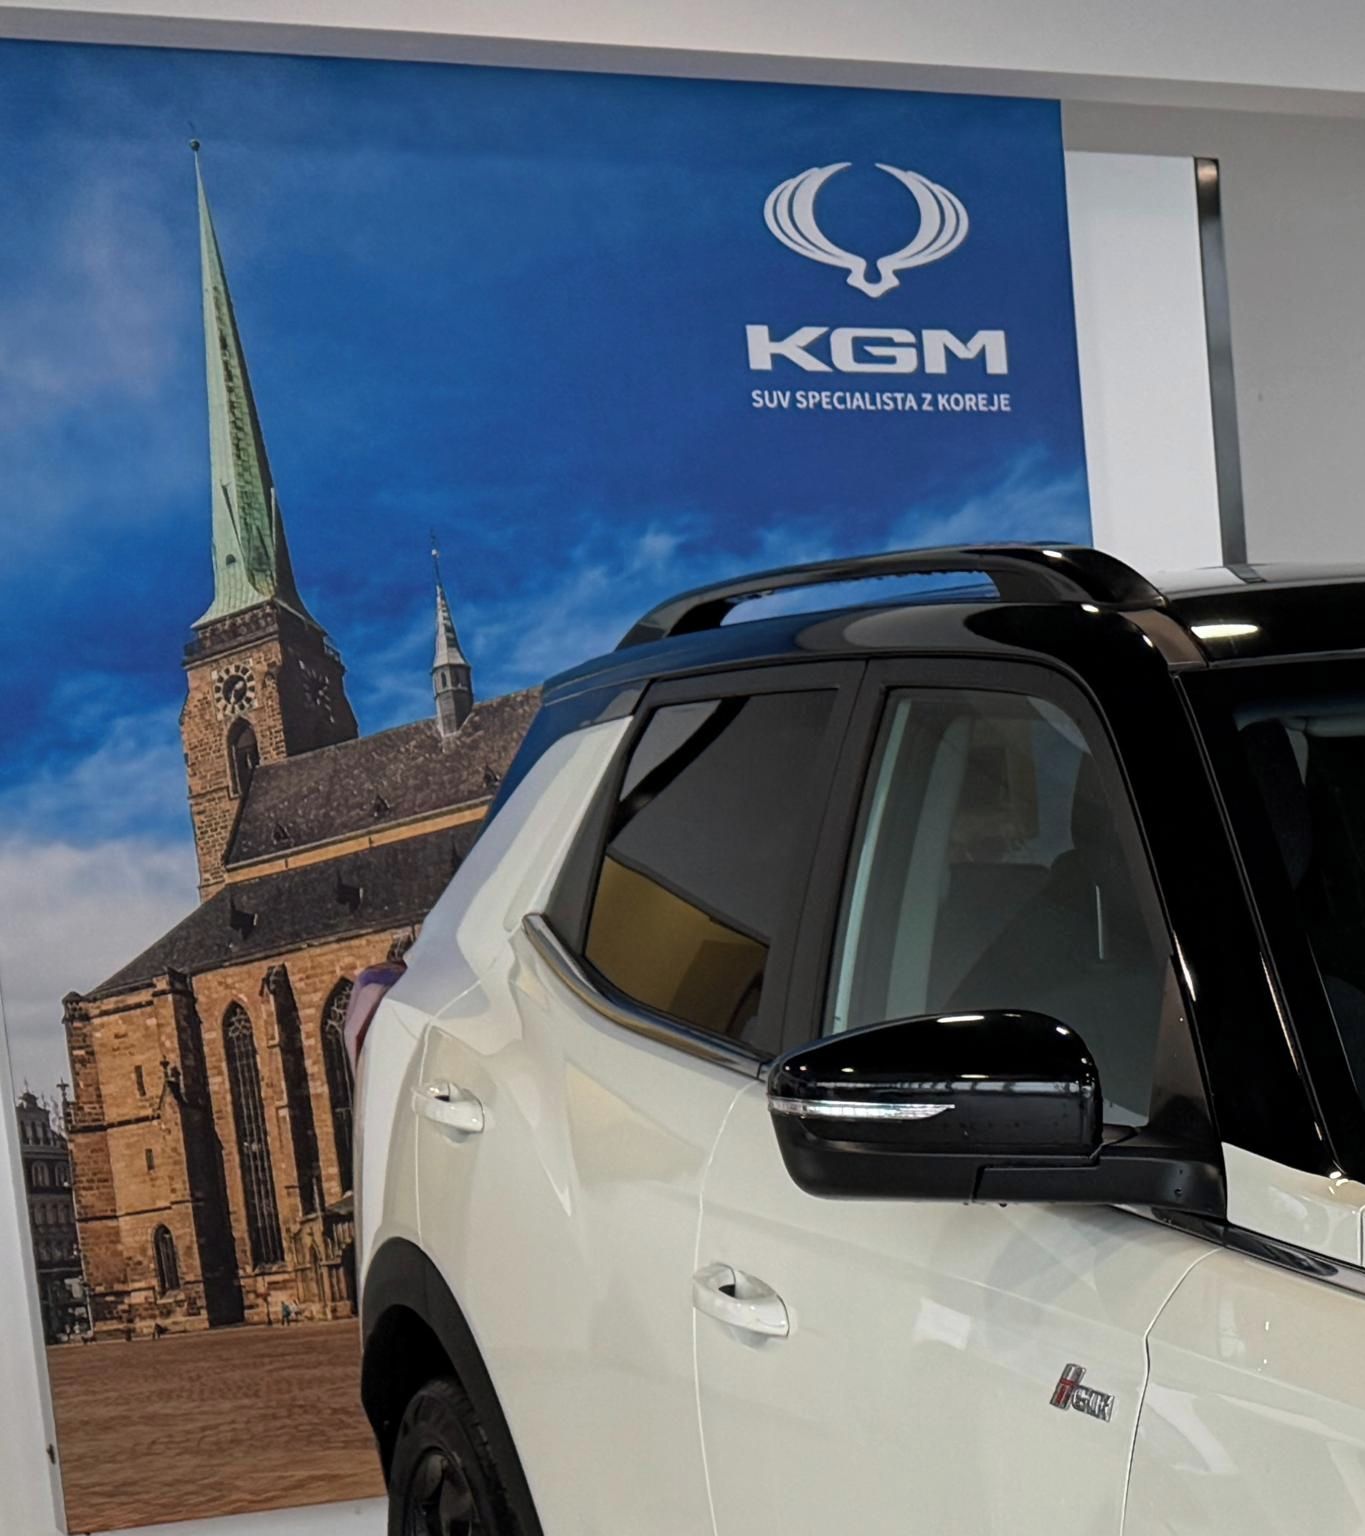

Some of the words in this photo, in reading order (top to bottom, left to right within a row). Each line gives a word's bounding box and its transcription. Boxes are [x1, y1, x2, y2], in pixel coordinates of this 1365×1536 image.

[745, 324, 1008, 375] KGM
[751, 389, 791, 409] SUV
[795, 390, 918, 411] SPECIALISTA
[921, 393, 934, 411] Z
[937, 393, 1012, 412] KOREJE
